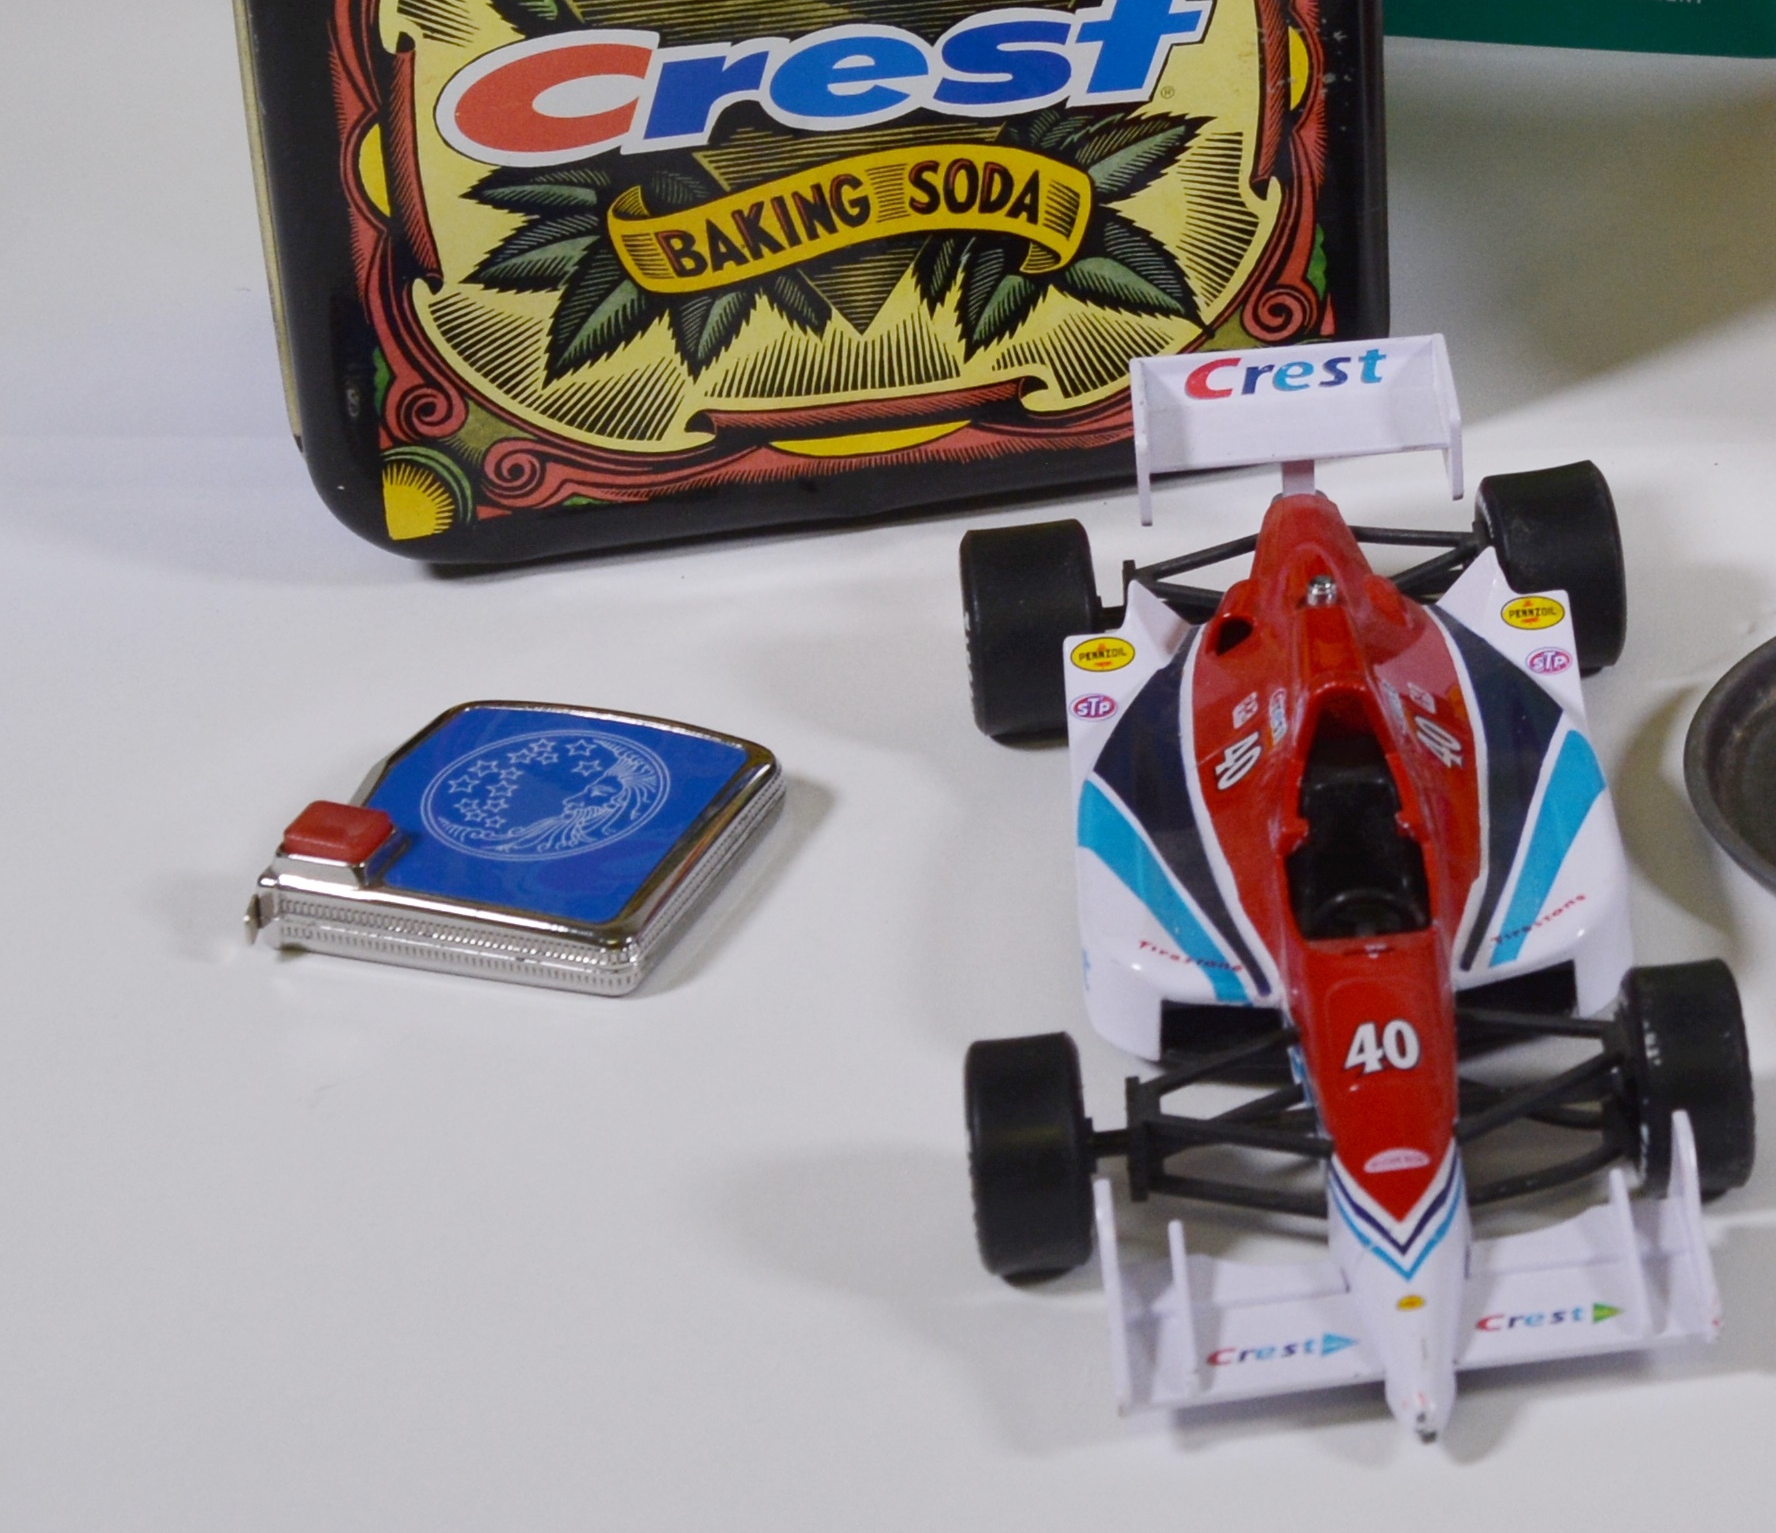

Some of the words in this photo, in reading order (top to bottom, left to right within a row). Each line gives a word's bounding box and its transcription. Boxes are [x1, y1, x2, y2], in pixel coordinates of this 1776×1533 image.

[656, 174, 873, 280] BAKING
[906, 157, 1043, 226] SODA
[1183, 347, 1388, 402] Crest
[1076, 696, 1111, 717] STP
[1214, 730, 1262, 791] 40
[1343, 1018, 1422, 1075] 40
